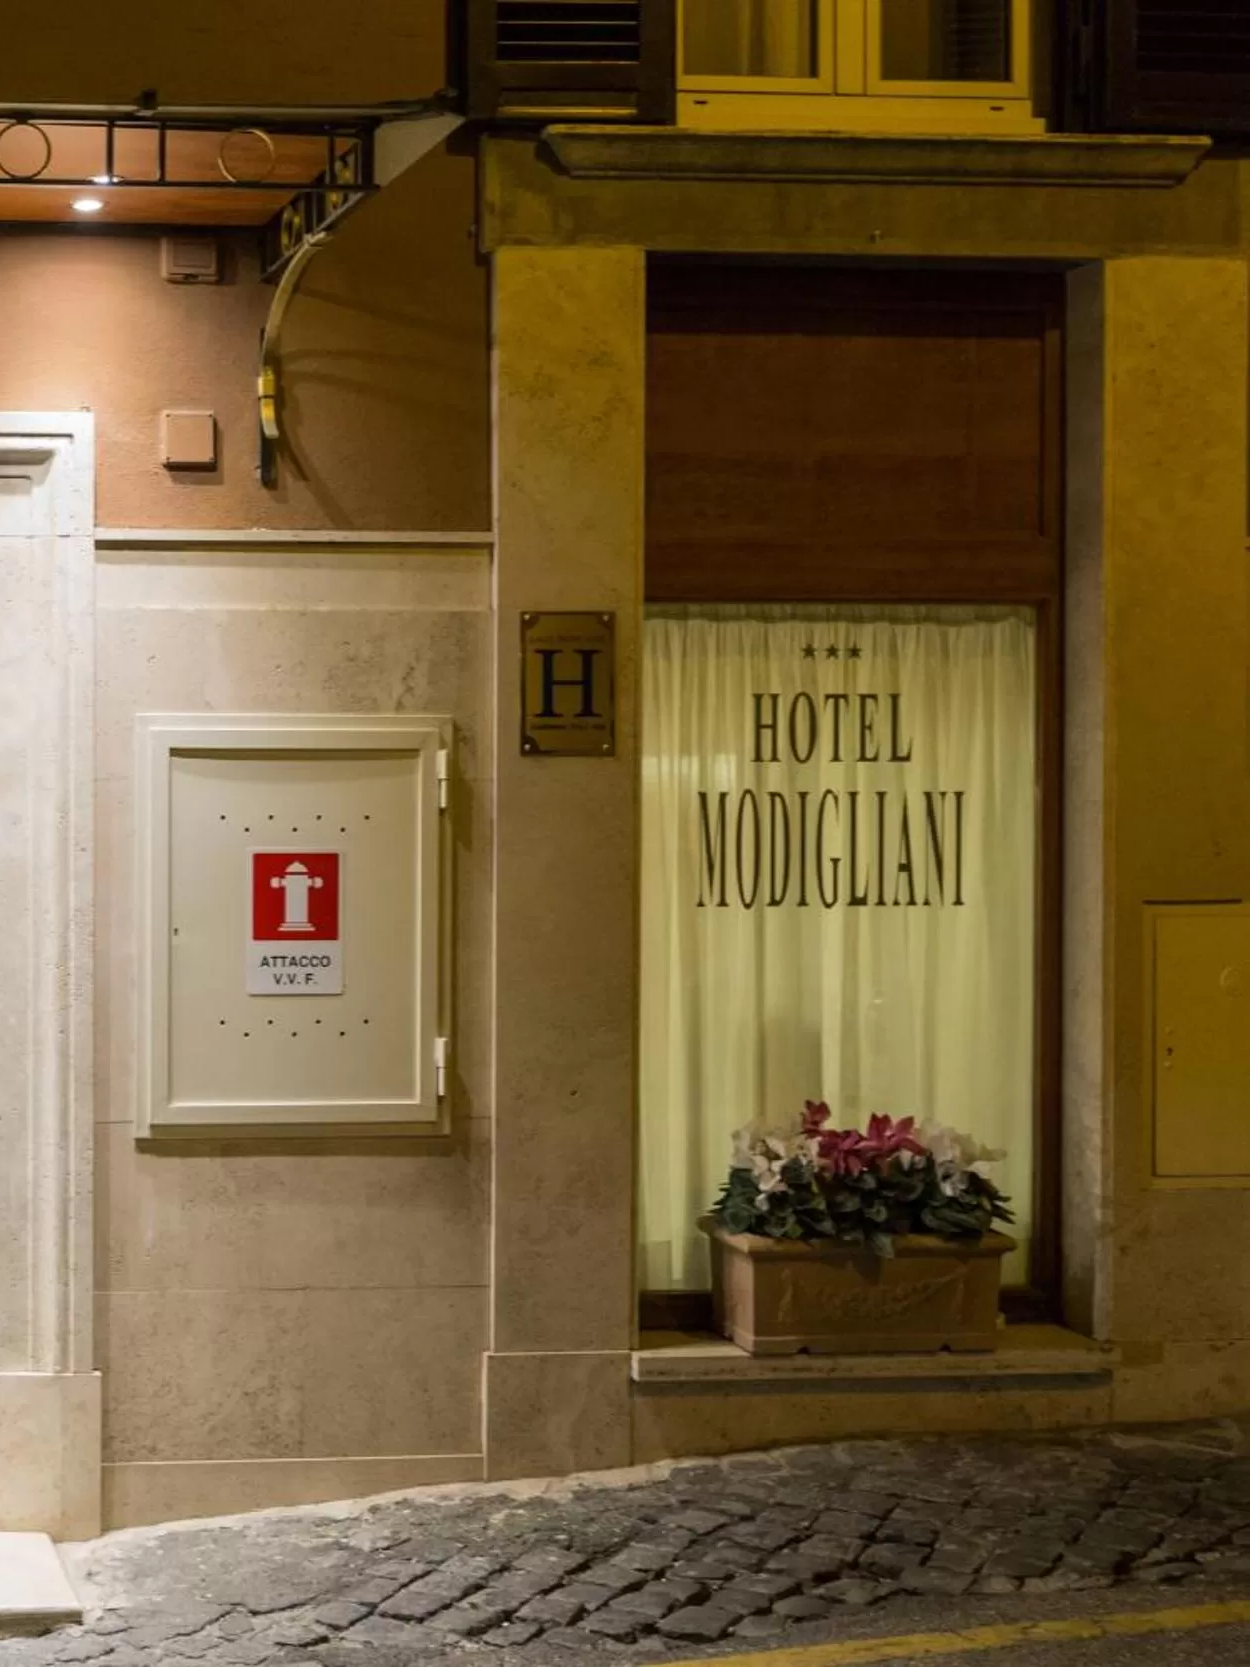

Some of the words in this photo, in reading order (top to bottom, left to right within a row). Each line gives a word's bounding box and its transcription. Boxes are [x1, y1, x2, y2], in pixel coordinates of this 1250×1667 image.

[534, 648, 602, 718] H
[751, 691, 914, 763] HOTEL
[696, 788, 965, 909] MODIGLIANI
[260, 955, 332, 968] ATTACCO
